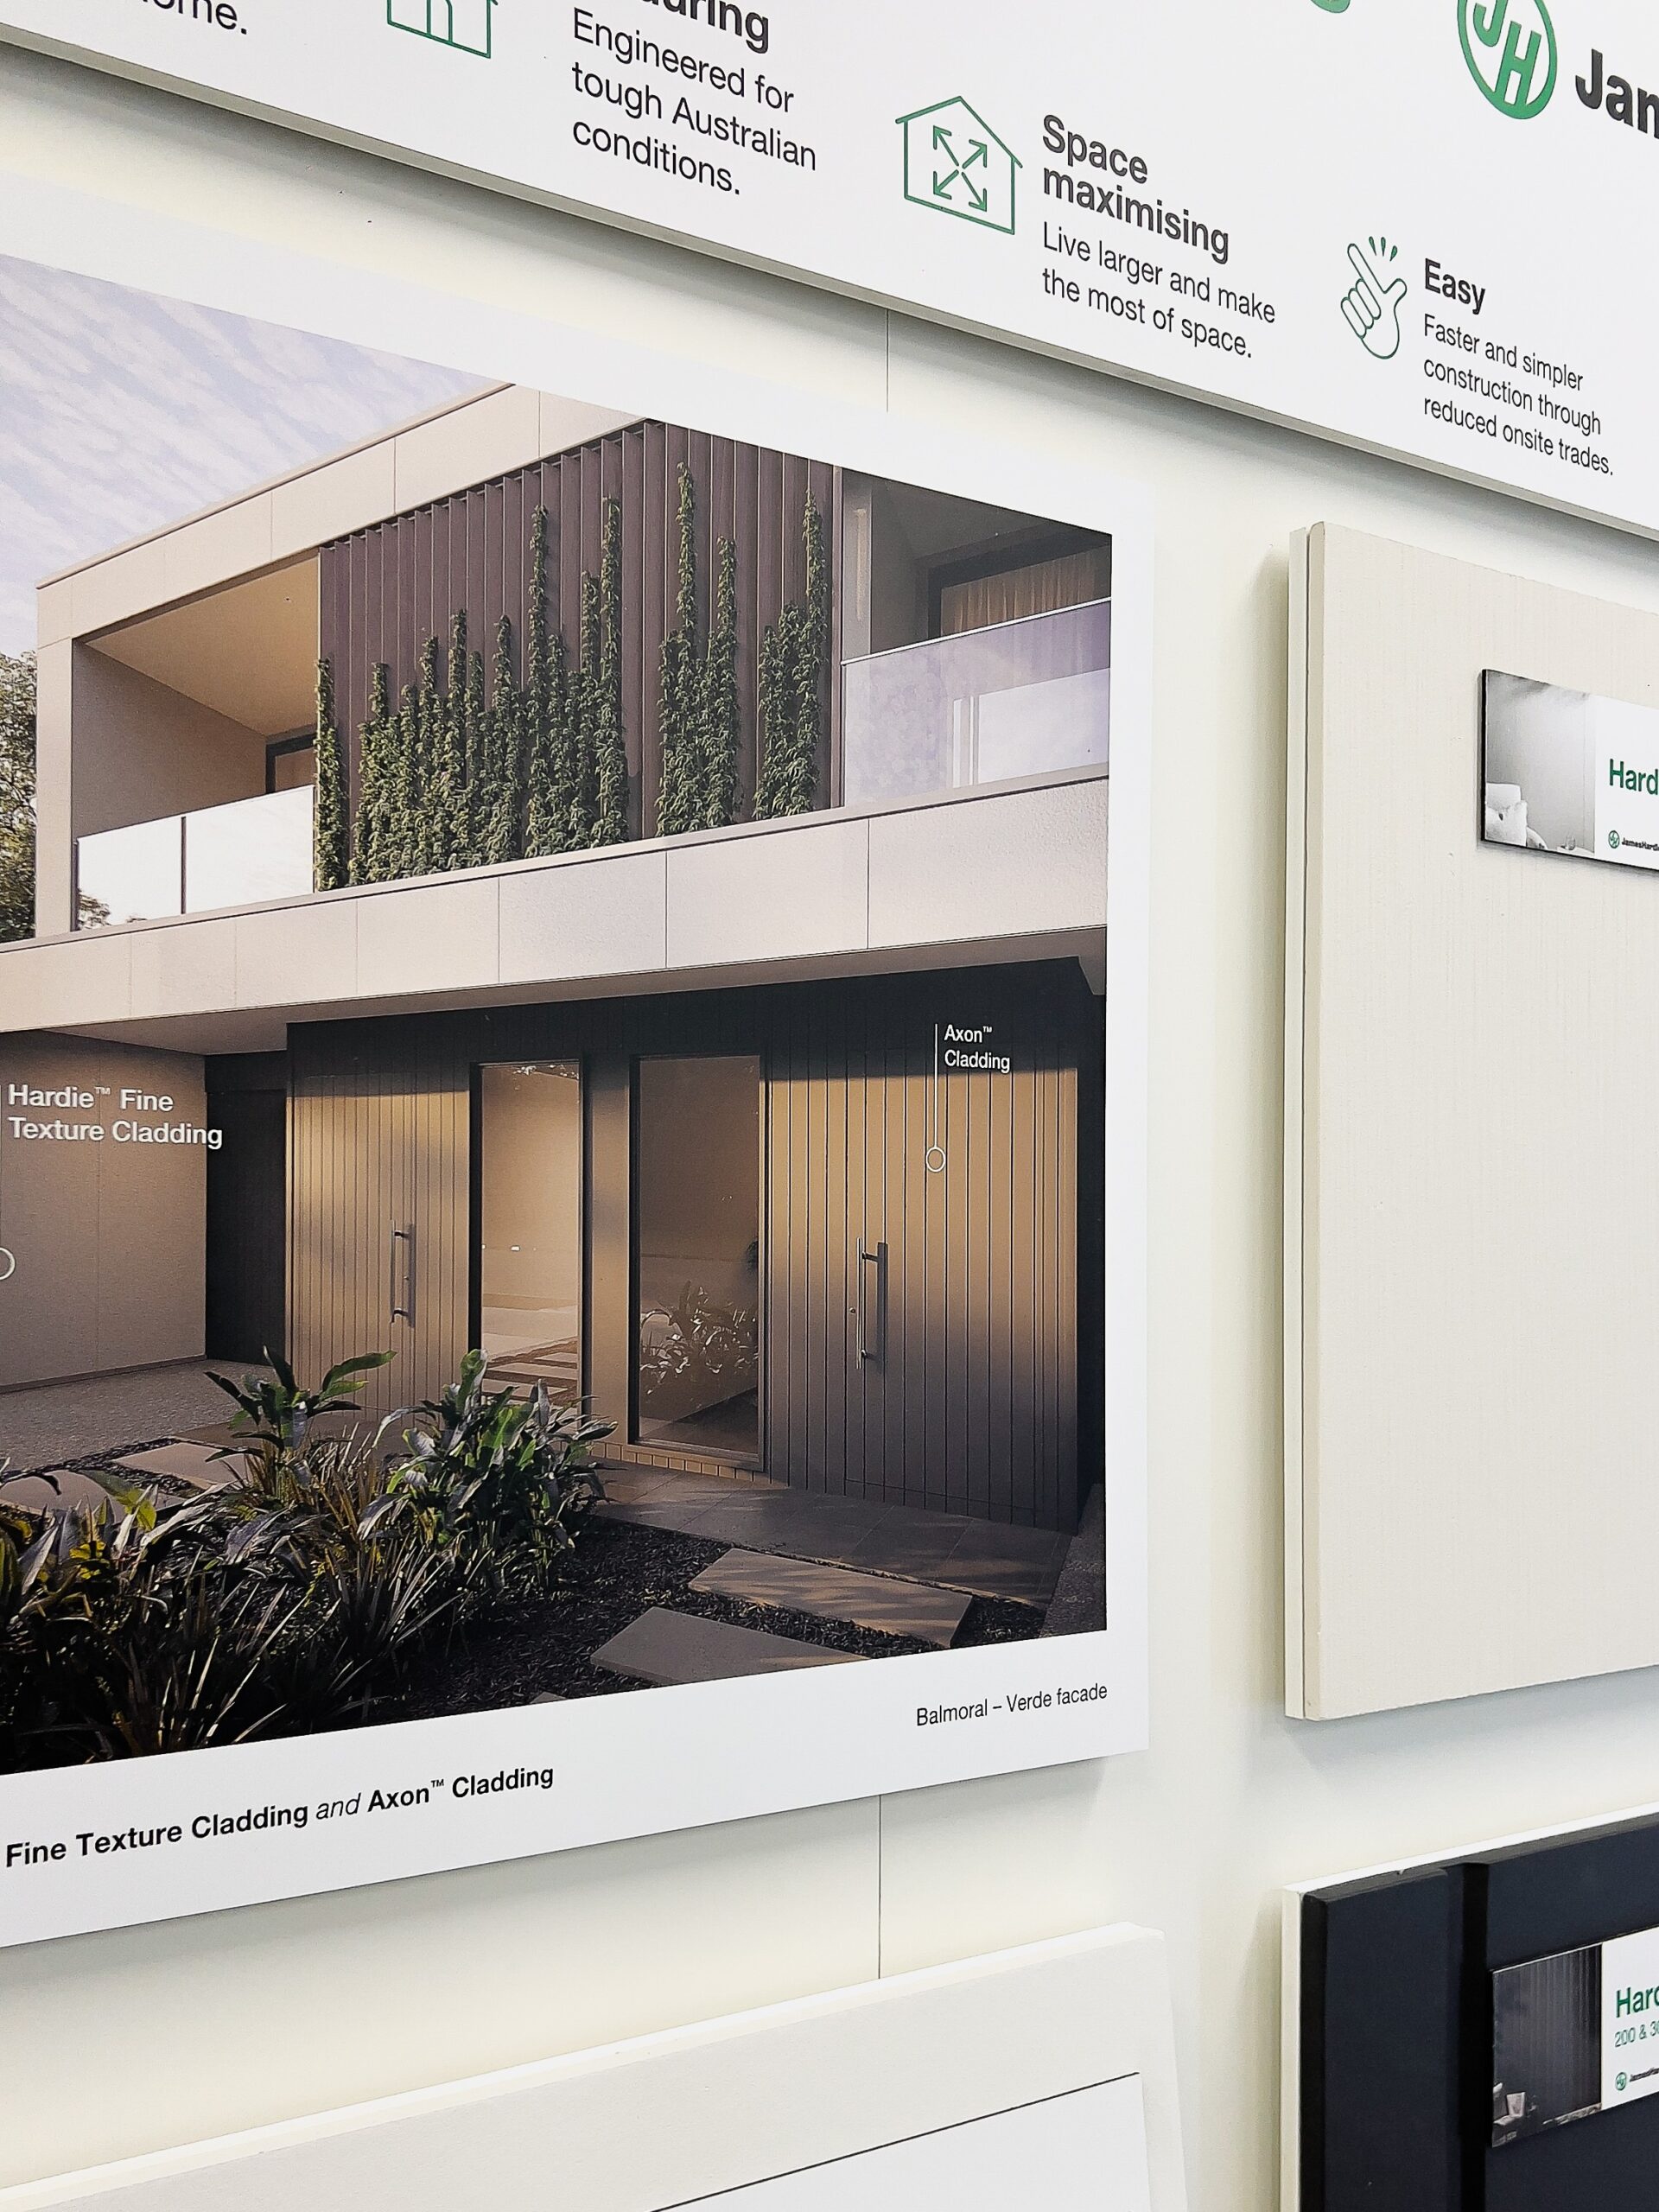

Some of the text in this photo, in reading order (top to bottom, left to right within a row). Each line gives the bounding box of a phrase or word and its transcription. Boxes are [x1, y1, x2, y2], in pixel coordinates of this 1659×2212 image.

[574, 7, 794, 114] Engineered for
[571, 61, 816, 171] tough Australian
[1042, 114, 1148, 184] Space
[573, 120, 741, 195] conditions.
[1043, 167, 1229, 264] maximising
[1043, 222, 1275, 324] Live larger and make
[1425, 258, 1485, 315] Easy
[1042, 269, 1251, 359] the most of space.
[1425, 314, 1583, 391] Faster and simpler
[1424, 359, 1601, 436] construction through
[1425, 398, 1613, 475] reduced onsite trades.
[944, 1050, 1010, 1073] Cladding
[8, 1116, 223, 1150] Texture Cladding
[120, 1089, 174, 1112] Fine
[917, 1699, 988, 1726] Balmoral
[1007, 1691, 1052, 1713] Verde
[1057, 1683, 1108, 1705] facade
[5, 1840, 67, 1867] Fine
[76, 1820, 182, 1856] Texture
[191, 1802, 308, 1839] Cladding
[315, 1794, 362, 1821] and
[452, 1766, 554, 1798] Cladding
[1614, 2027, 1636, 2048] 200
[1639, 2024, 1648, 2040] &
